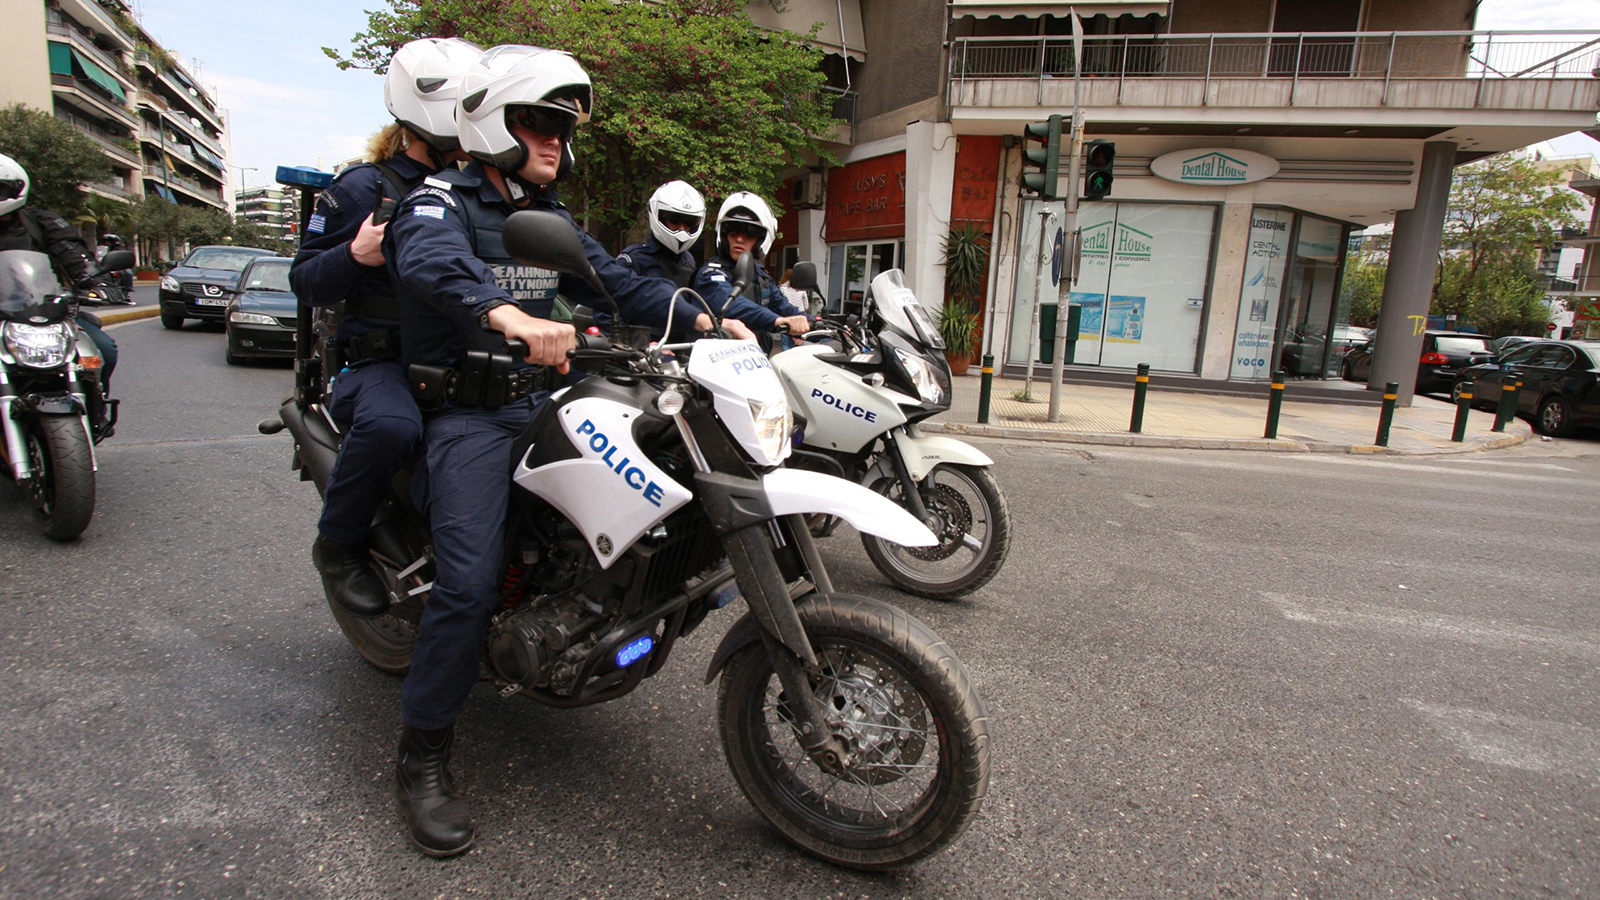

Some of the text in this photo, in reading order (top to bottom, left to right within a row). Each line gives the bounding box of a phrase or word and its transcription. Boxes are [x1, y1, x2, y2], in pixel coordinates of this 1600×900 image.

[1182, 157, 1247, 177] Dental House
[866, 196, 888, 212] BAR
[1252, 218, 1287, 231] LISTERINE
[1081, 227, 1152, 252] ental House
[1253, 241, 1280, 250] DENTAL
[1252, 250, 1280, 258] ACTION
[512, 290, 547, 300] POLICE
[1237, 357, 1265, 367] VOCO
[811, 388, 877, 423] POLICE
[575, 419, 665, 508] POLICE
